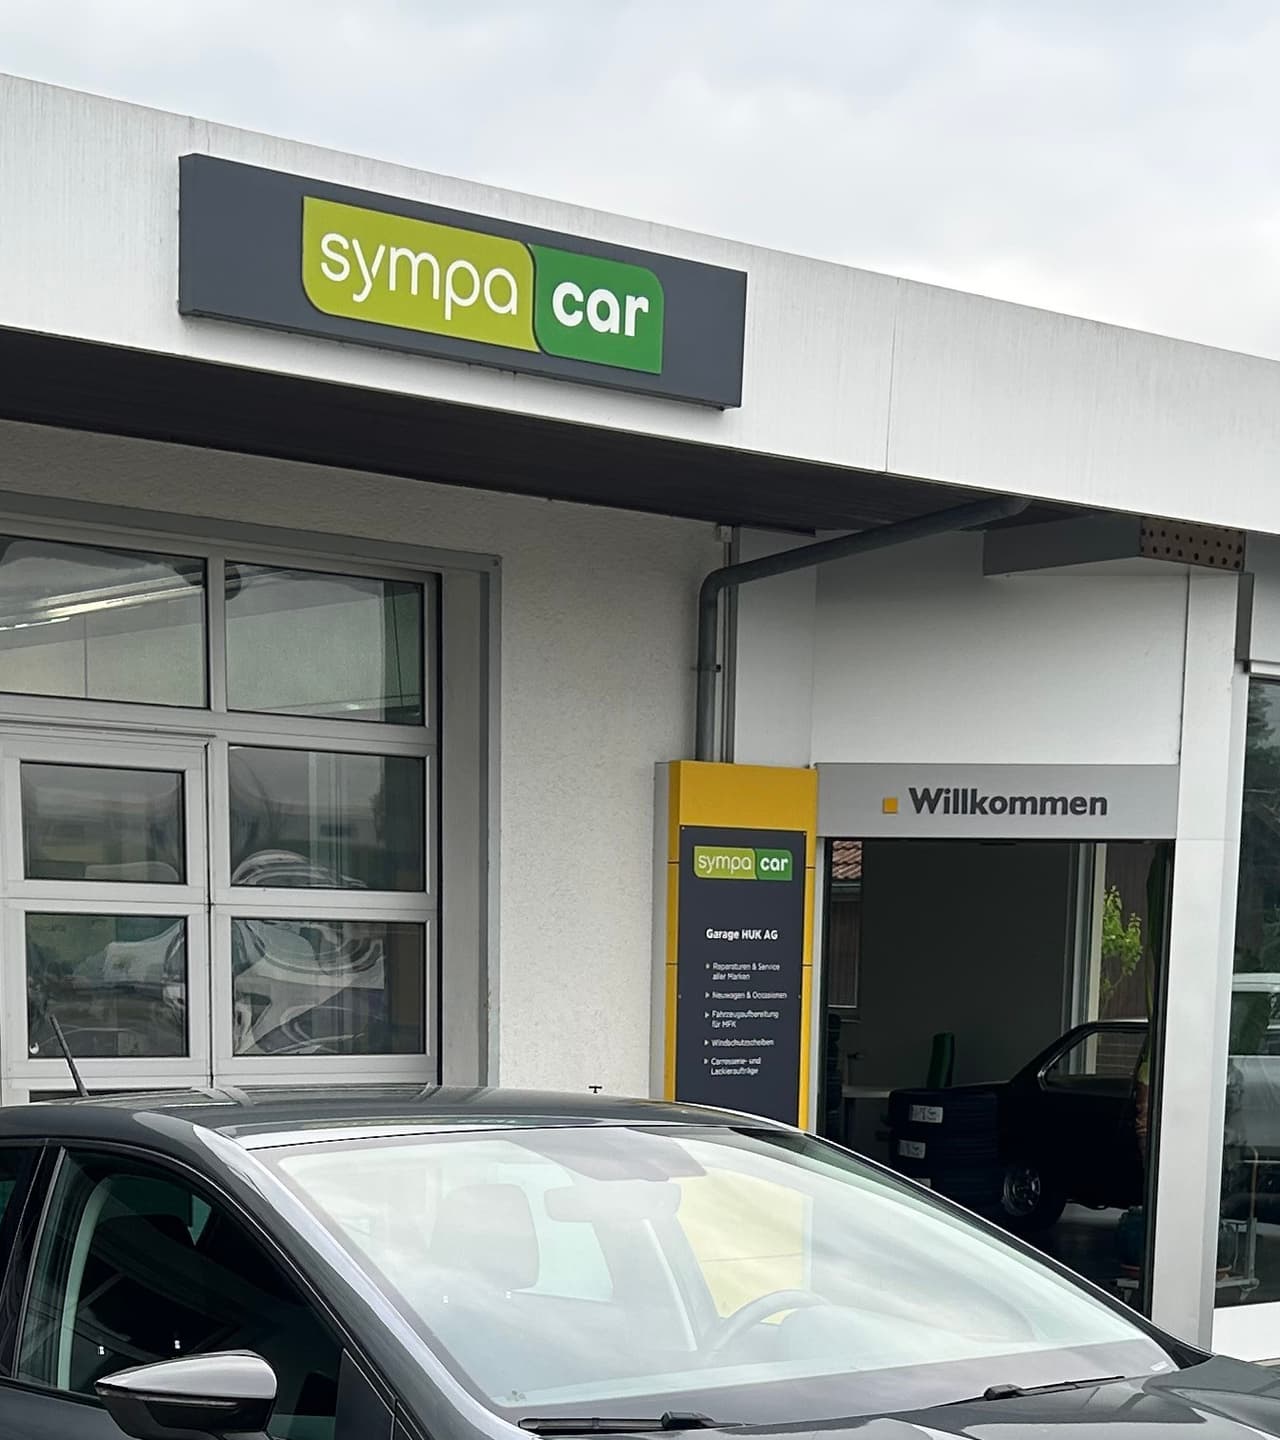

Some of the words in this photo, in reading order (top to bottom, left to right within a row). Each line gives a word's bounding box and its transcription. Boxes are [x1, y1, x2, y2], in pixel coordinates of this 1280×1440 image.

[319, 231, 519, 321] sympa
[551, 279, 651, 338] car
[907, 785, 1109, 818] Willkommen
[697, 854, 753, 875] sympa
[759, 856, 789, 872] car
[705, 927, 740, 941] Garage
[741, 928, 762, 940] HUK
[763, 929, 779, 940] AG
